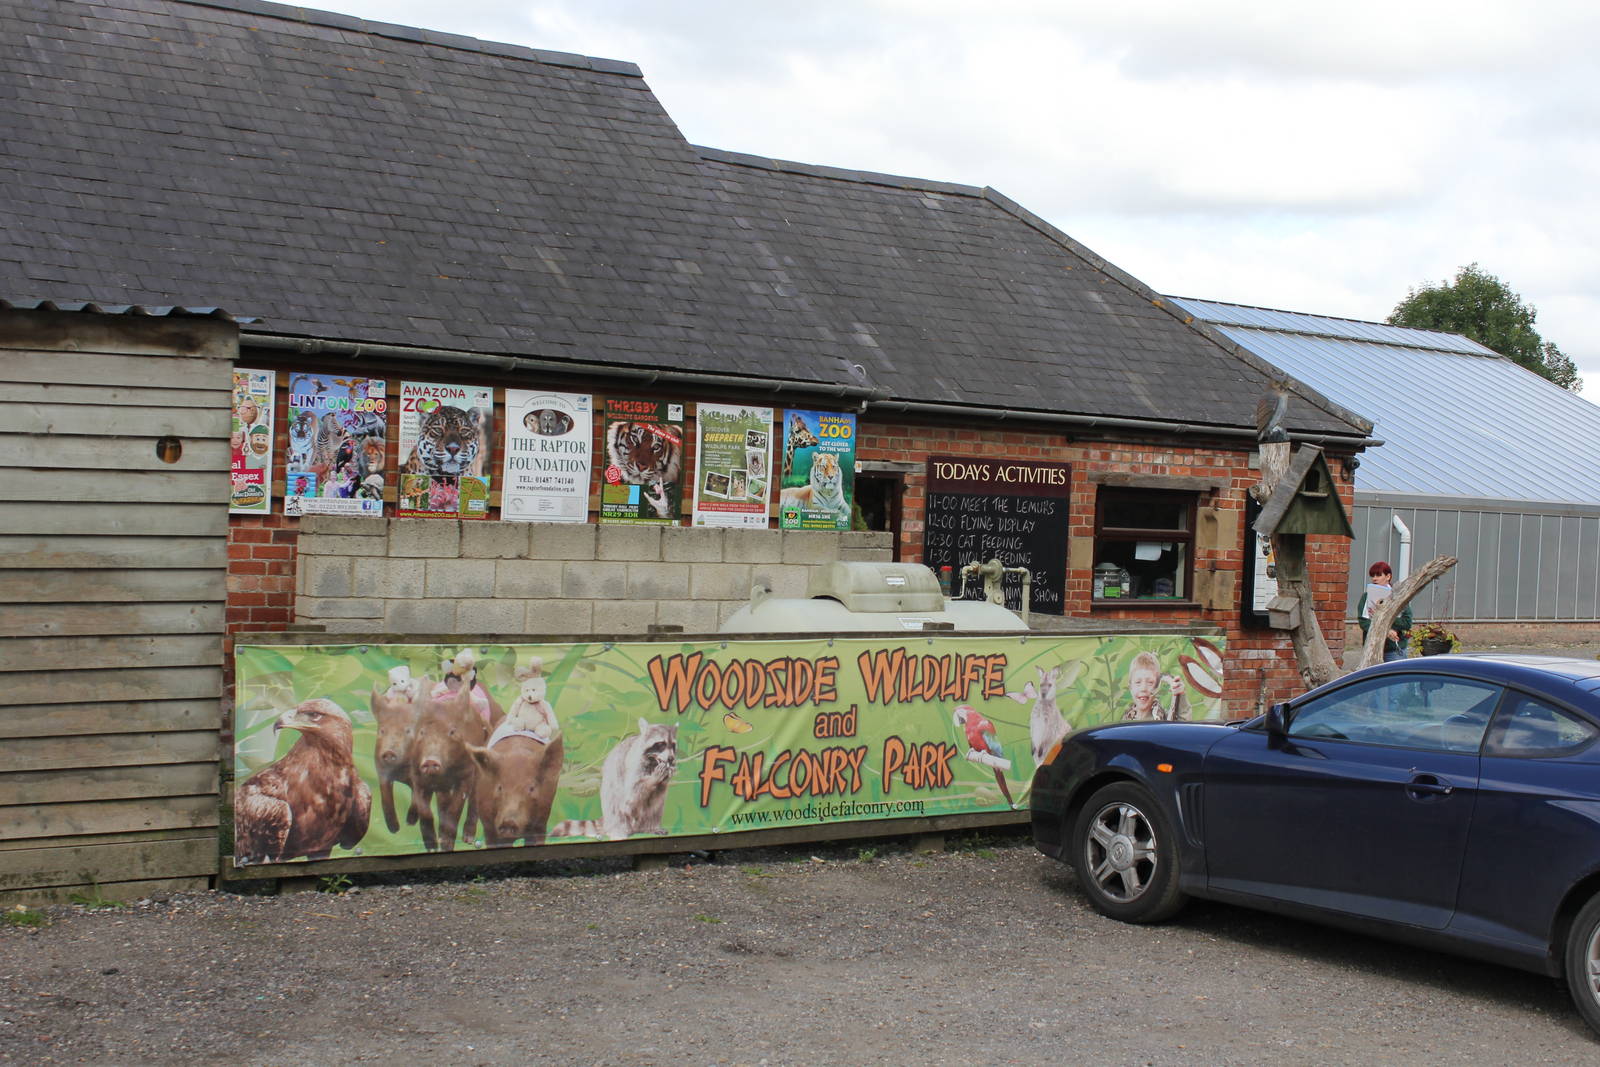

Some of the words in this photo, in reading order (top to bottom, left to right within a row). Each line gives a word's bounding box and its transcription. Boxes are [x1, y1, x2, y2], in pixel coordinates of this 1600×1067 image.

[404, 385, 466, 399] AMAZONA
[290, 394, 349, 410] LINTON
[354, 398, 387, 412] ZOO
[403, 397, 442, 414] ZOO
[606, 400, 658, 414] THRIGBY
[704, 433, 745, 443] SHEPRETH
[818, 424, 852, 438] ZOO
[512, 438, 536, 452] THE
[540, 440, 586, 455] RAPTOR
[509, 456, 587, 472] FOUNDATION
[231, 472, 260, 480] Essex
[934, 462, 990, 481] TODAYS
[995, 466, 1066, 486] ACTIVITIES
[960, 497, 989, 512] MEET
[992, 496, 1008, 512] THE
[1016, 498, 1056, 515] LEMURS
[960, 514, 994, 532] FLYING
[998, 517, 1036, 534] DISPLAY
[957, 534, 976, 549] CAT
[981, 534, 1023, 550] FEEDING
[958, 550, 988, 566] WOLF
[994, 549, 1032, 566] FEEDING
[814, 704, 858, 738] and
[731, 800, 925, 825] www.woodsidefalconry.com
